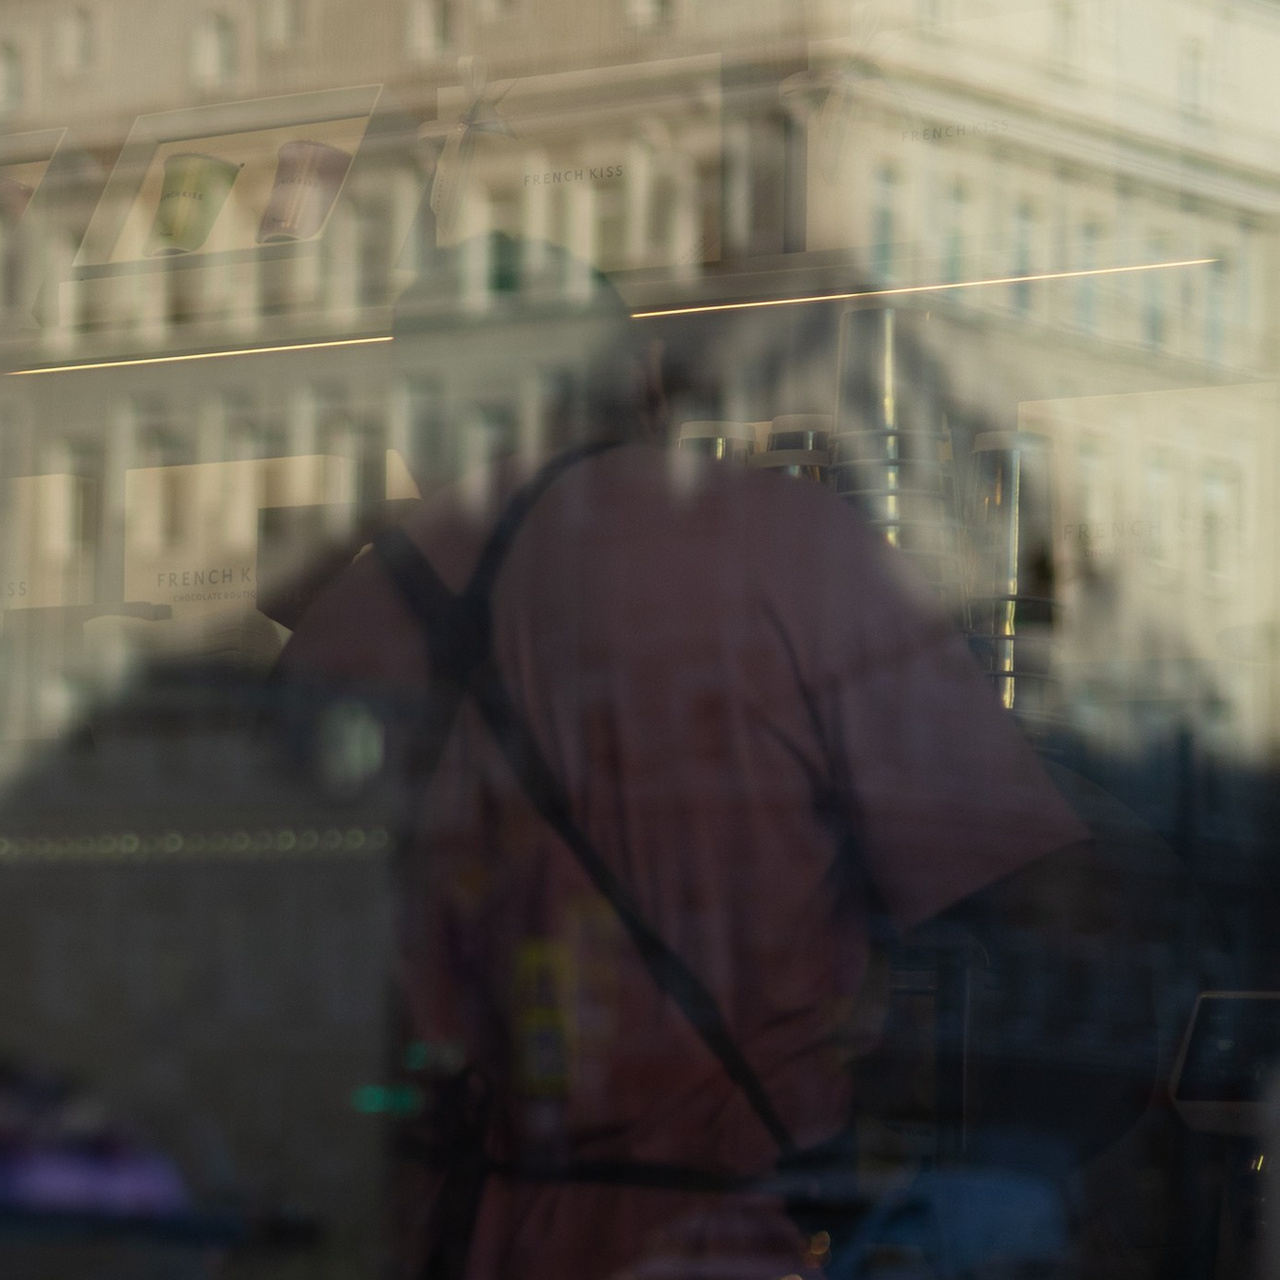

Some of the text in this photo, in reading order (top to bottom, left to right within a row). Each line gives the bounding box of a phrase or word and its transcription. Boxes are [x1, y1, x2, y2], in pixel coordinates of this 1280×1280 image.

[901, 124, 966, 142] FRENCH
[523, 164, 623, 187] FRENCH KISS
[157, 568, 234, 588] FRENCH
